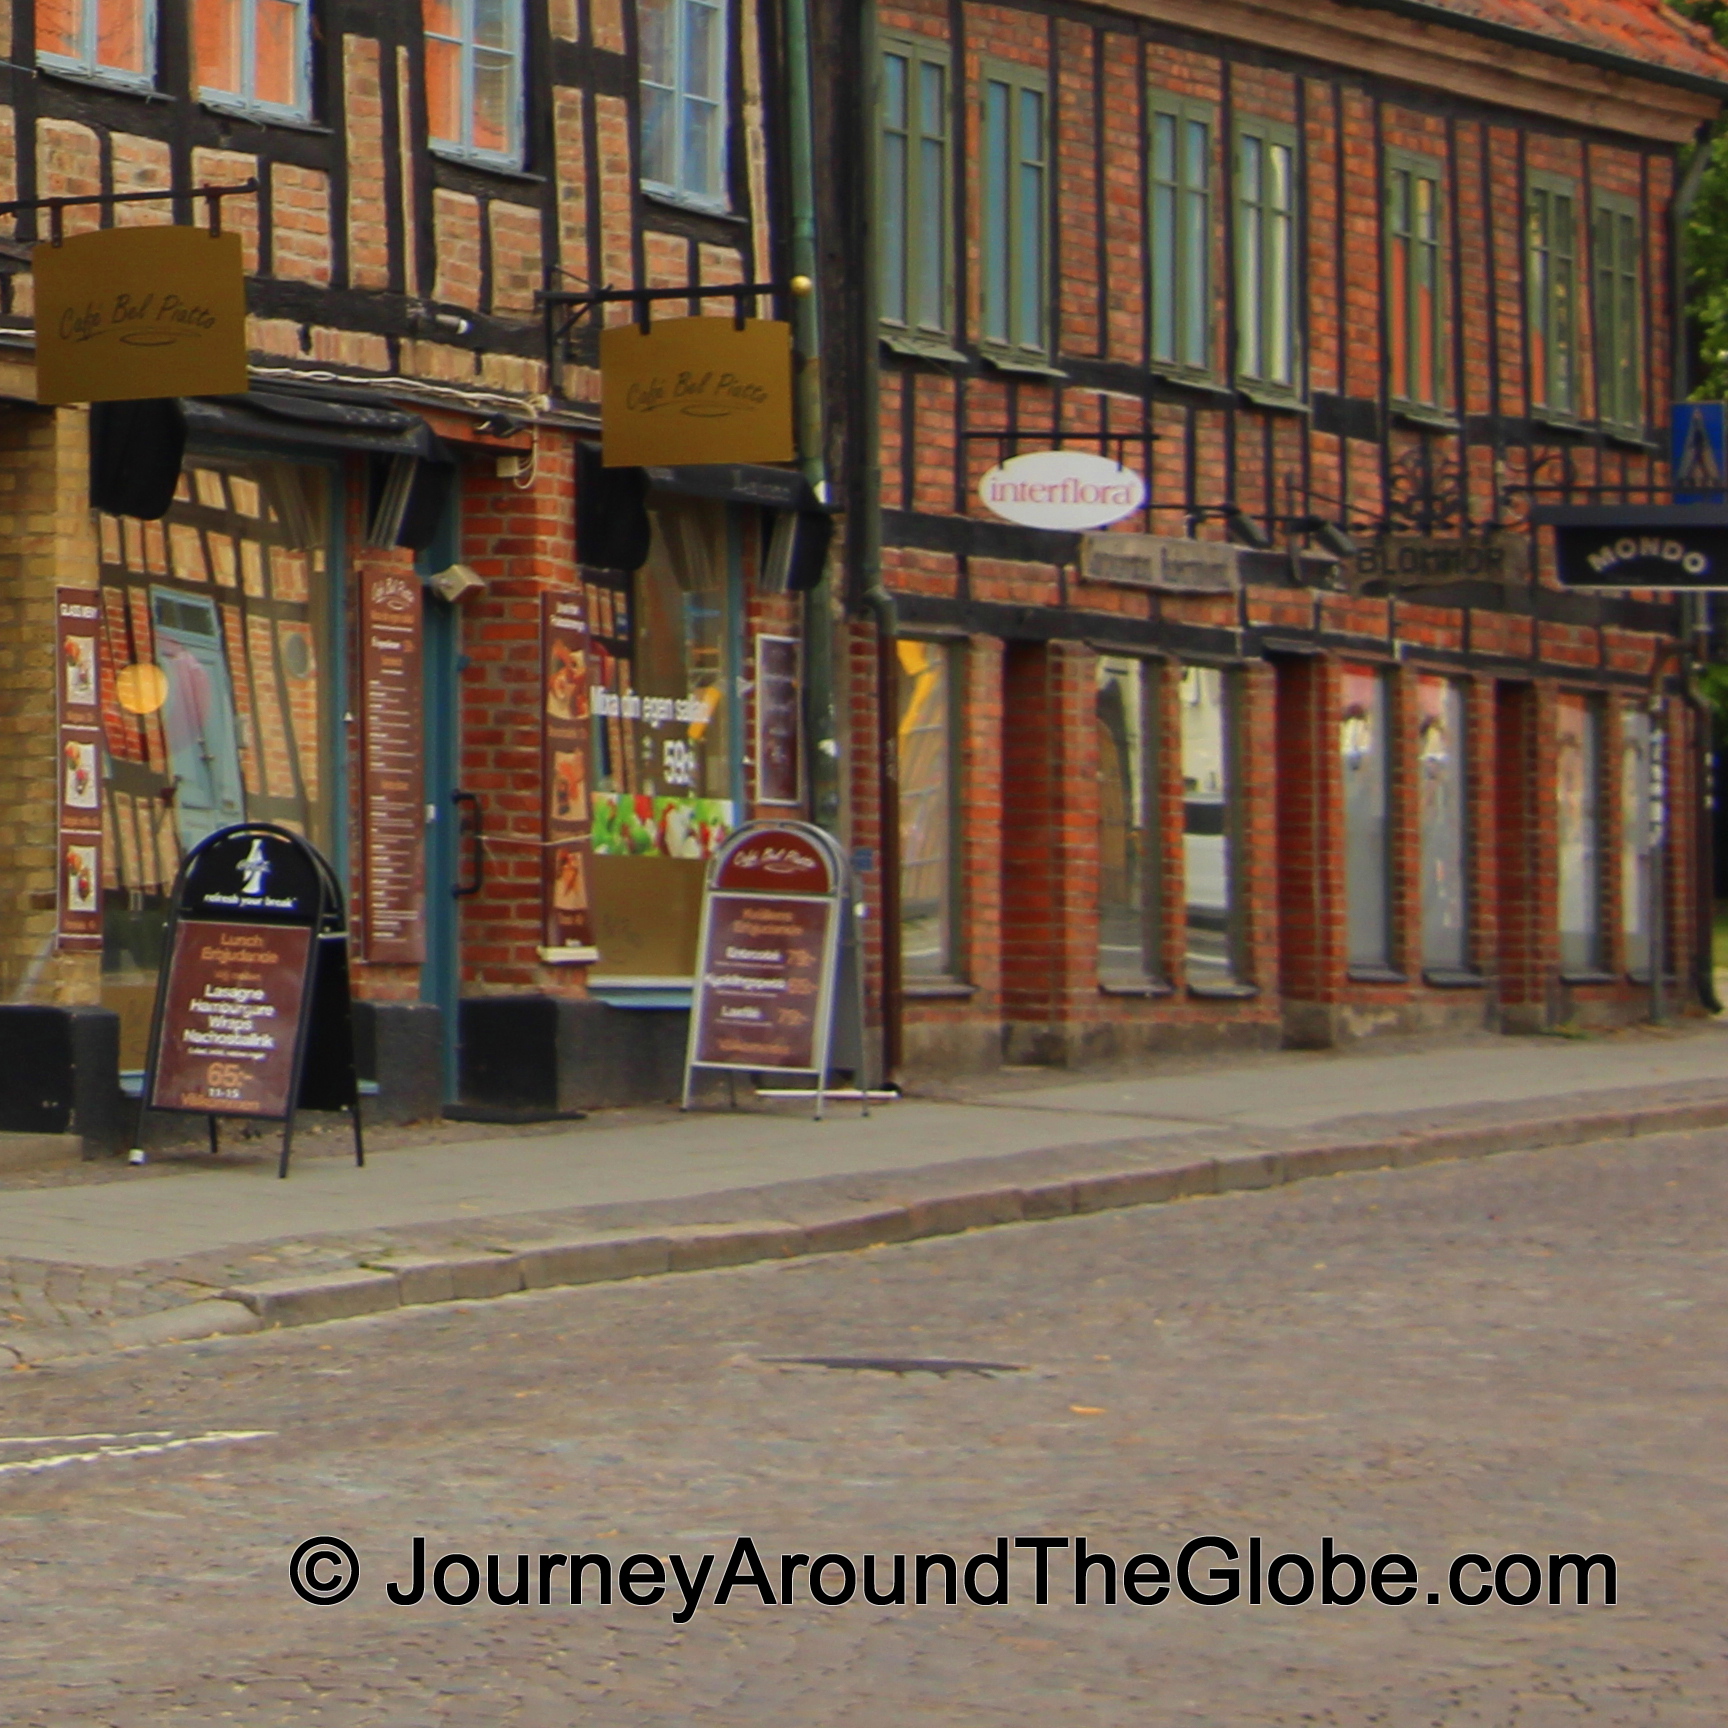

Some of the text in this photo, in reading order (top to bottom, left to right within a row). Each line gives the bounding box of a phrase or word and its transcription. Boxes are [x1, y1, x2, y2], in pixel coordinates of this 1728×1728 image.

[990, 477, 1132, 505] interflora
[1587, 536, 1708, 574] MONDO
[239, 897, 264, 908] your
[220, 933, 264, 947] Lunch
[200, 946, 280, 964] Erbjudande
[203, 983, 266, 1004] Lasagne
